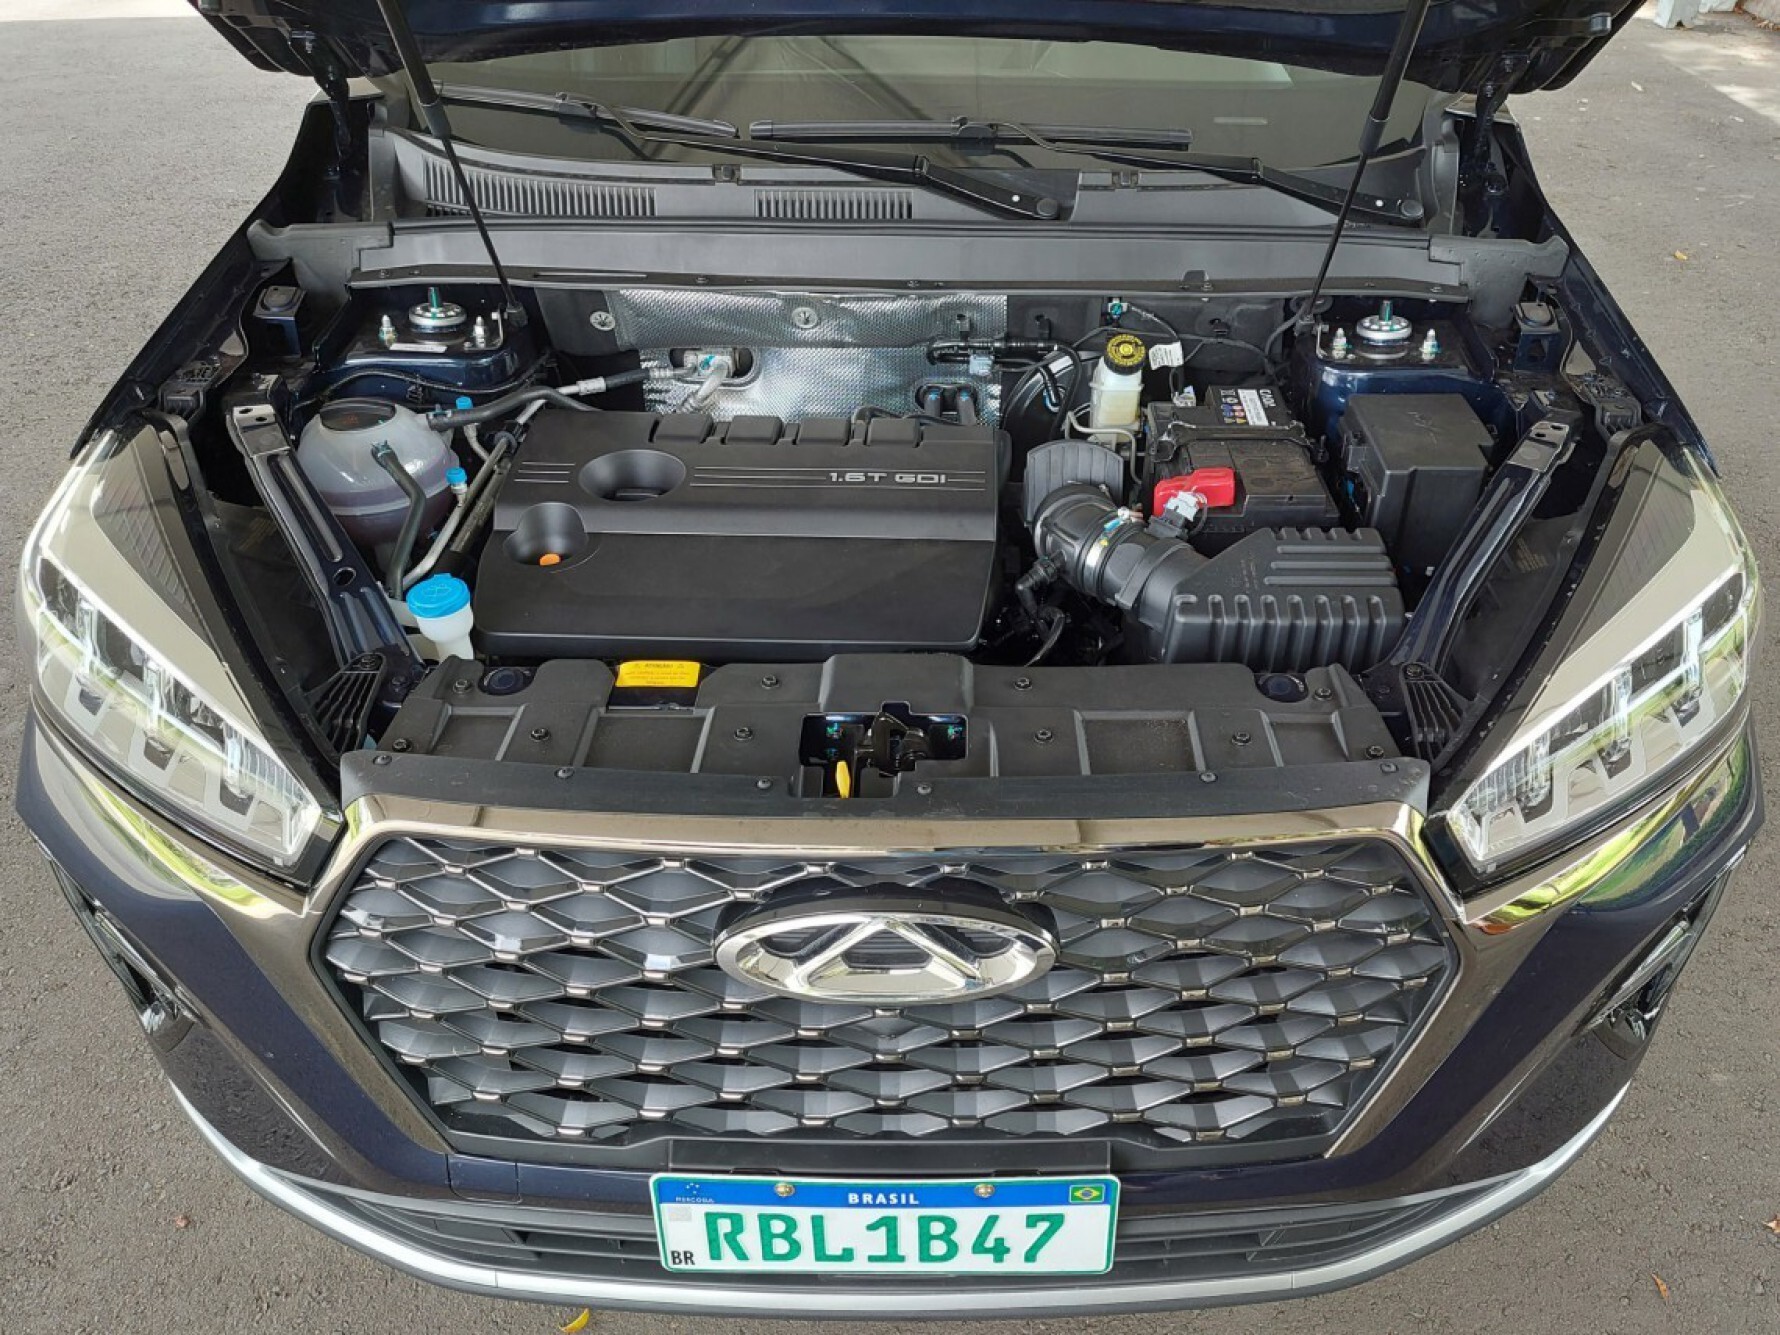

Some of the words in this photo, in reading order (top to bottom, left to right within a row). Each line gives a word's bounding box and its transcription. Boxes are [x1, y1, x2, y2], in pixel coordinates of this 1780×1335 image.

[828, 472, 888, 482] 1.6T
[894, 473, 946, 484] GDI
[848, 1192, 920, 1205] BRASIL
[704, 1211, 1066, 1263] RBL1B47
[670, 1250, 696, 1266] BR
